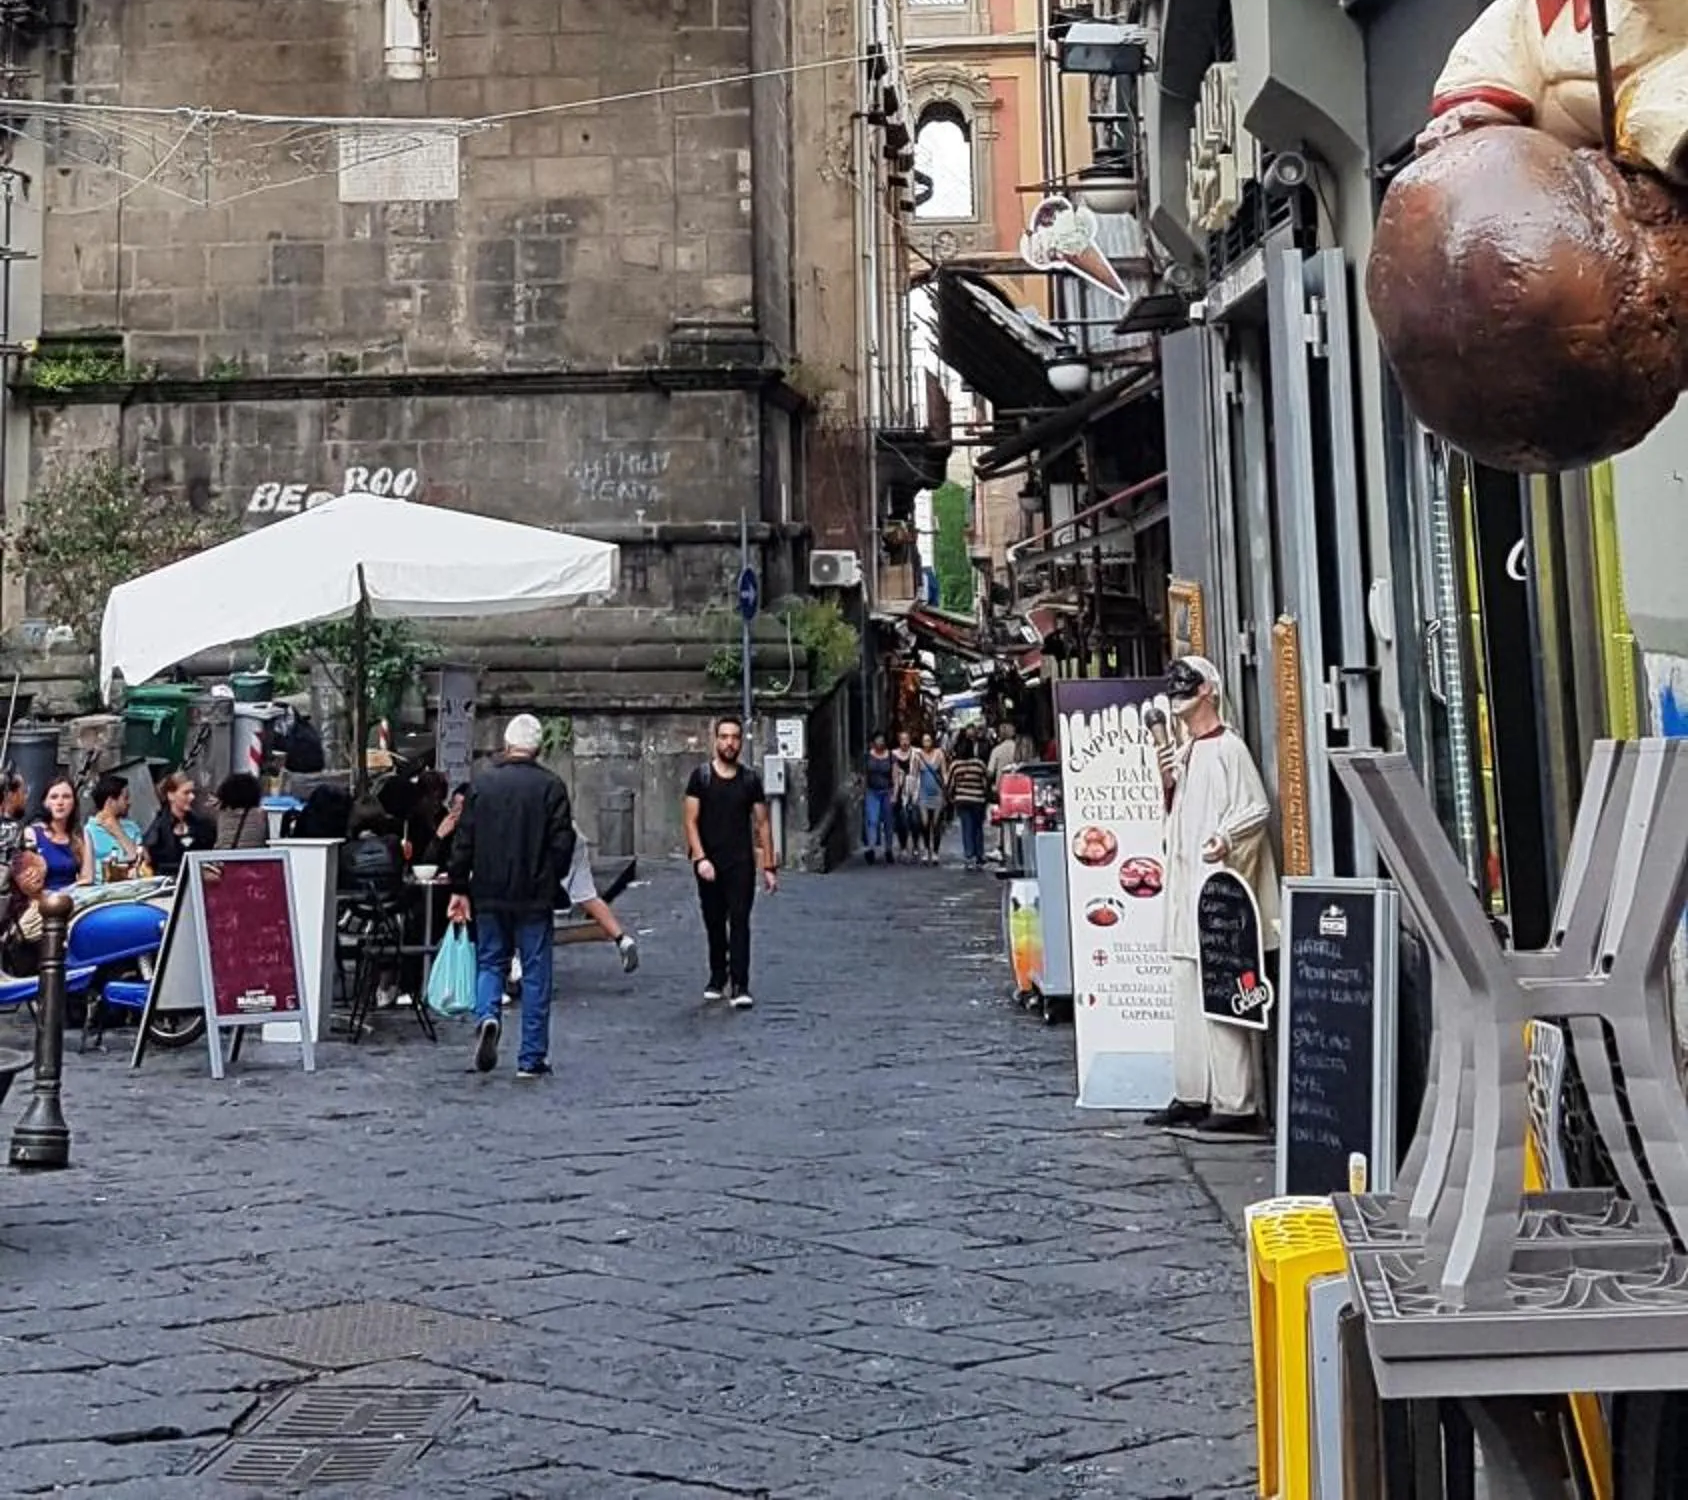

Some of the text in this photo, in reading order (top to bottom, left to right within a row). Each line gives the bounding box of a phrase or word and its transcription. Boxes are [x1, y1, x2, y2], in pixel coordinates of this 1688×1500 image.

[1069, 727, 1150, 773] CAPPAR
[1116, 767, 1153, 782] BAR
[1081, 803, 1160, 820] GELATE
